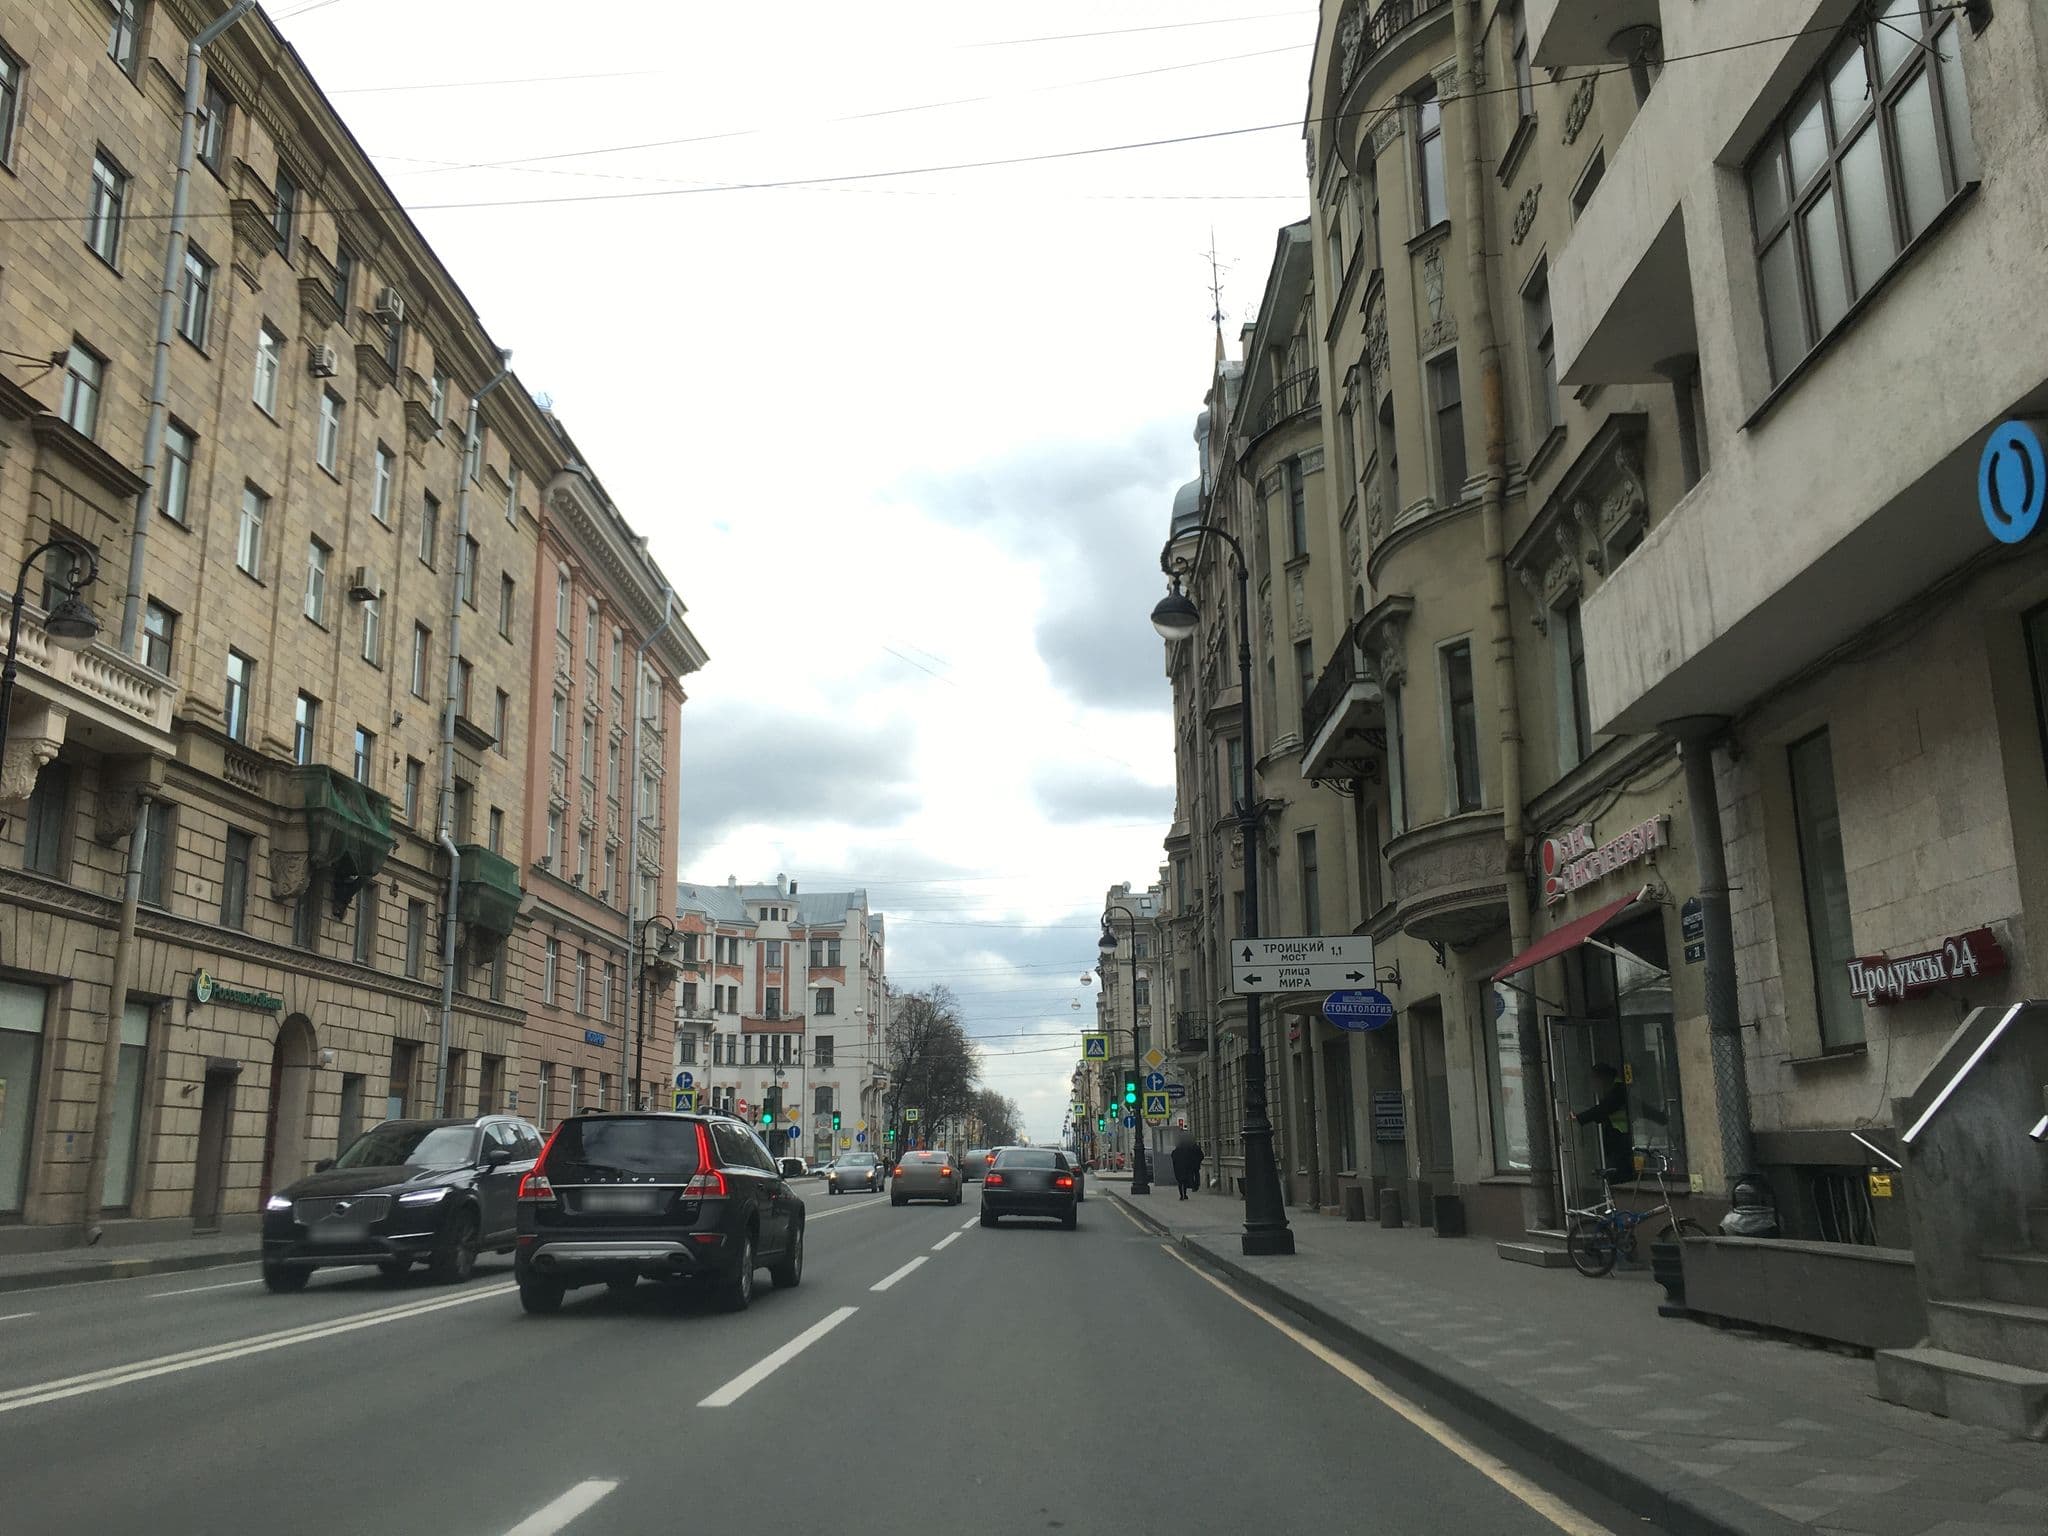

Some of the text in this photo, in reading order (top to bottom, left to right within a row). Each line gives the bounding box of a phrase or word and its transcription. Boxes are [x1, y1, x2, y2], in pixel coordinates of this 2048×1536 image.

[1263, 940, 1325, 954] ТРОИЦКИЙ
[1279, 967, 1311, 977] улица
[1848, 938, 1978, 1001] Продукты 24
[1279, 978, 1312, 988] МИРА
[1325, 1004, 1393, 1014] СТОМАТОЛОГИЯ
